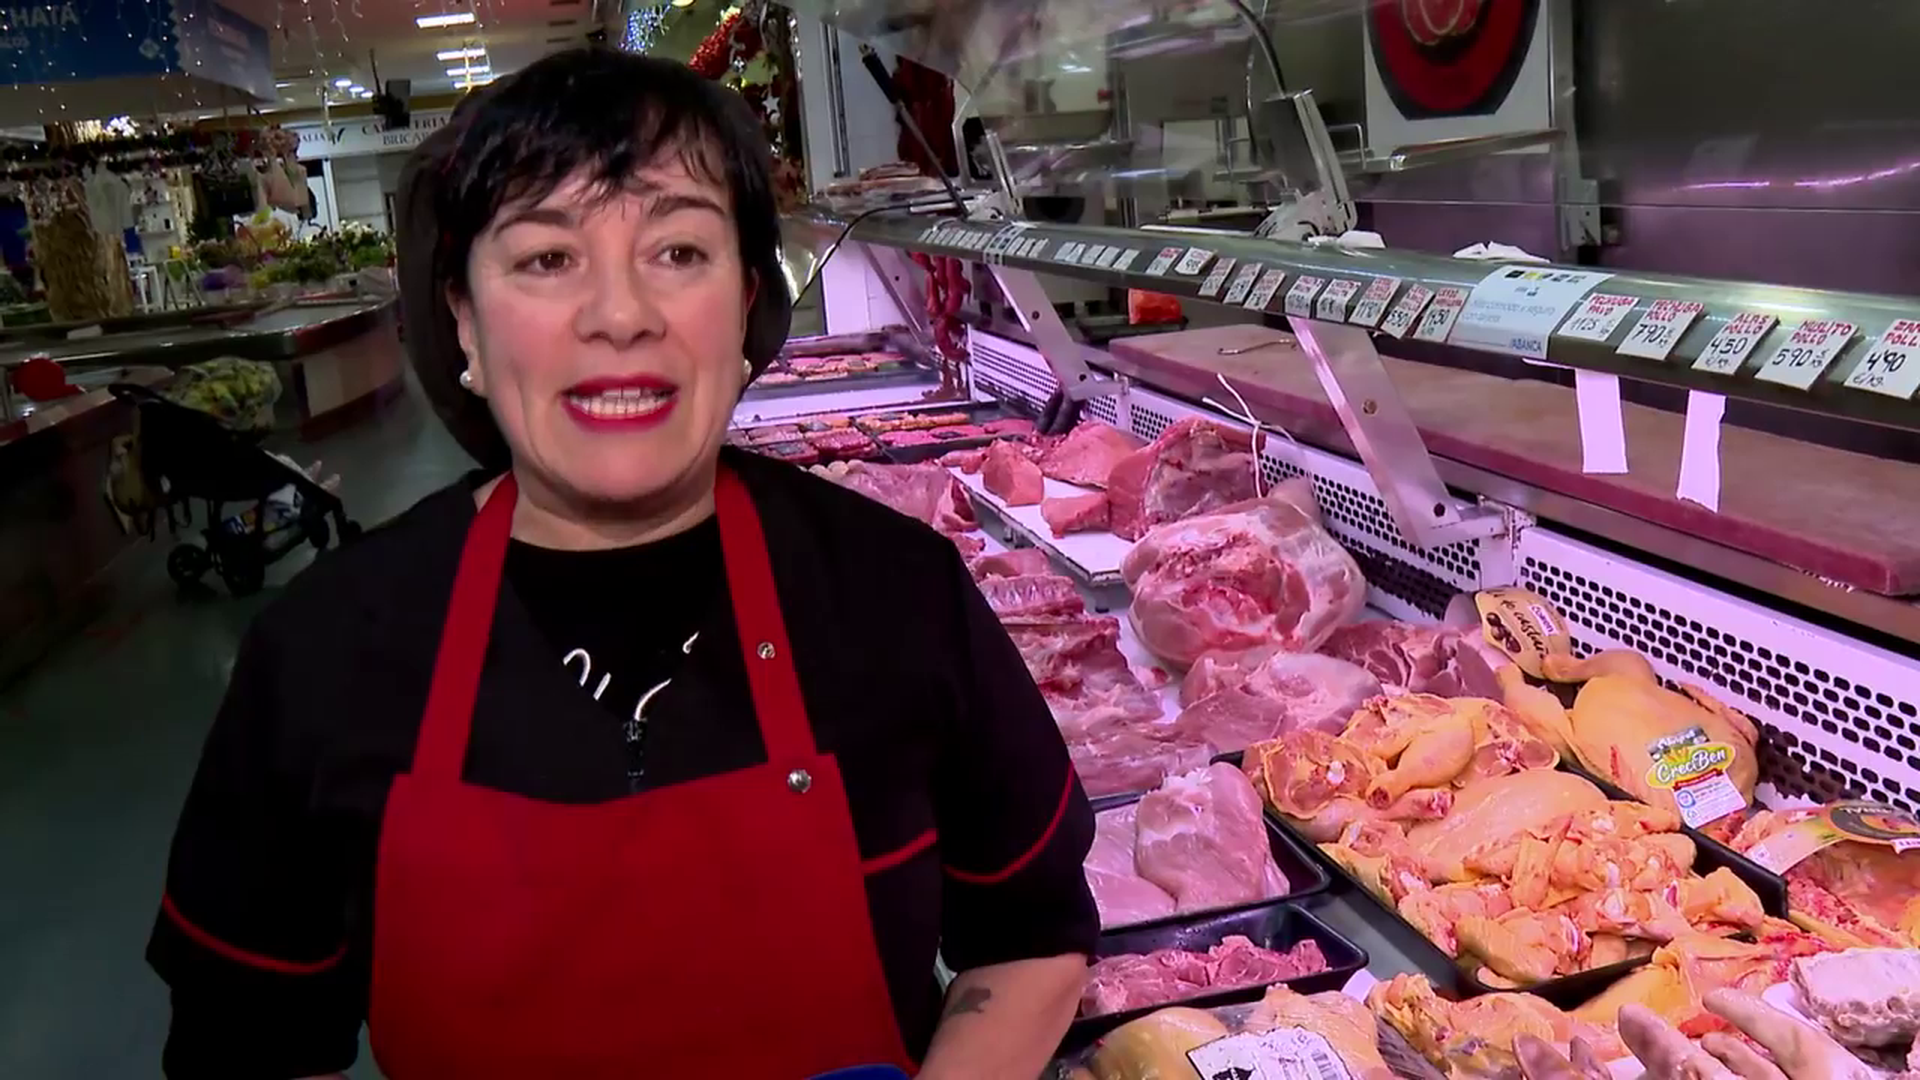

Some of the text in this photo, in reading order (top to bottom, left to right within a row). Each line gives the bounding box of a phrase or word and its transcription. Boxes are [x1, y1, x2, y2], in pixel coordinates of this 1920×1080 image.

[1587, 305, 1614, 316] PAVO
[1655, 301, 1704, 313] PECHUGA
[1645, 310, 1676, 323] POLLO
[1733, 313, 1769, 325] ALAS
[1722, 324, 1763, 334] POLLO
[1799, 320, 1852, 336] MUSLITO
[1790, 332, 1827, 345] POLLO
[1883, 332, 1920, 347] POLL
